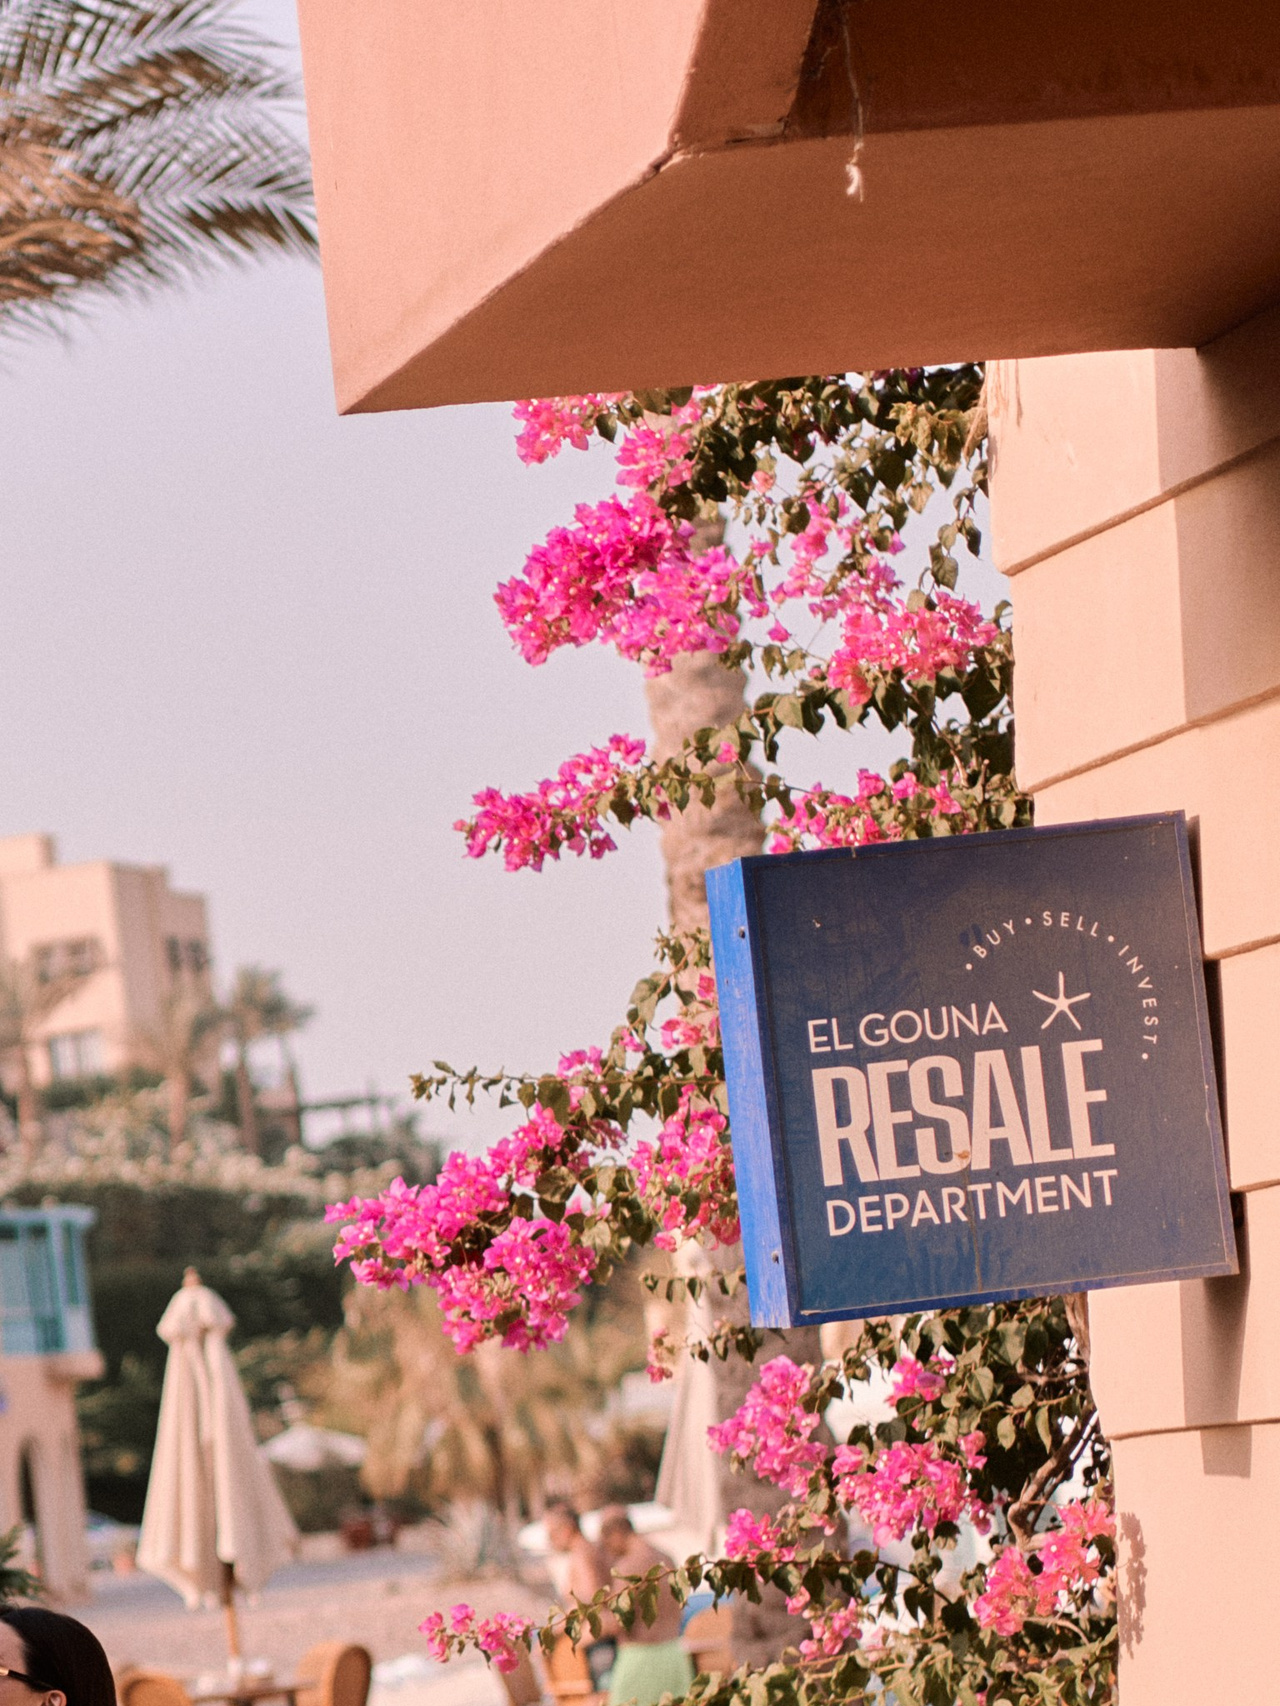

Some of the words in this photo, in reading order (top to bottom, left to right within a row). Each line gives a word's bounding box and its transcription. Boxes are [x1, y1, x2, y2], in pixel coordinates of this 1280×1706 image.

[808, 1018, 853, 1053] EL
[860, 1001, 1009, 1047] GOUNA
[973, 920, 1018, 959] BUY
[1042, 911, 1099, 938] SELL
[1117, 945, 1159, 1045] INVEST
[811, 1039, 1115, 1187] RESALE
[826, 1169, 1118, 1236] DEPARTMENT
